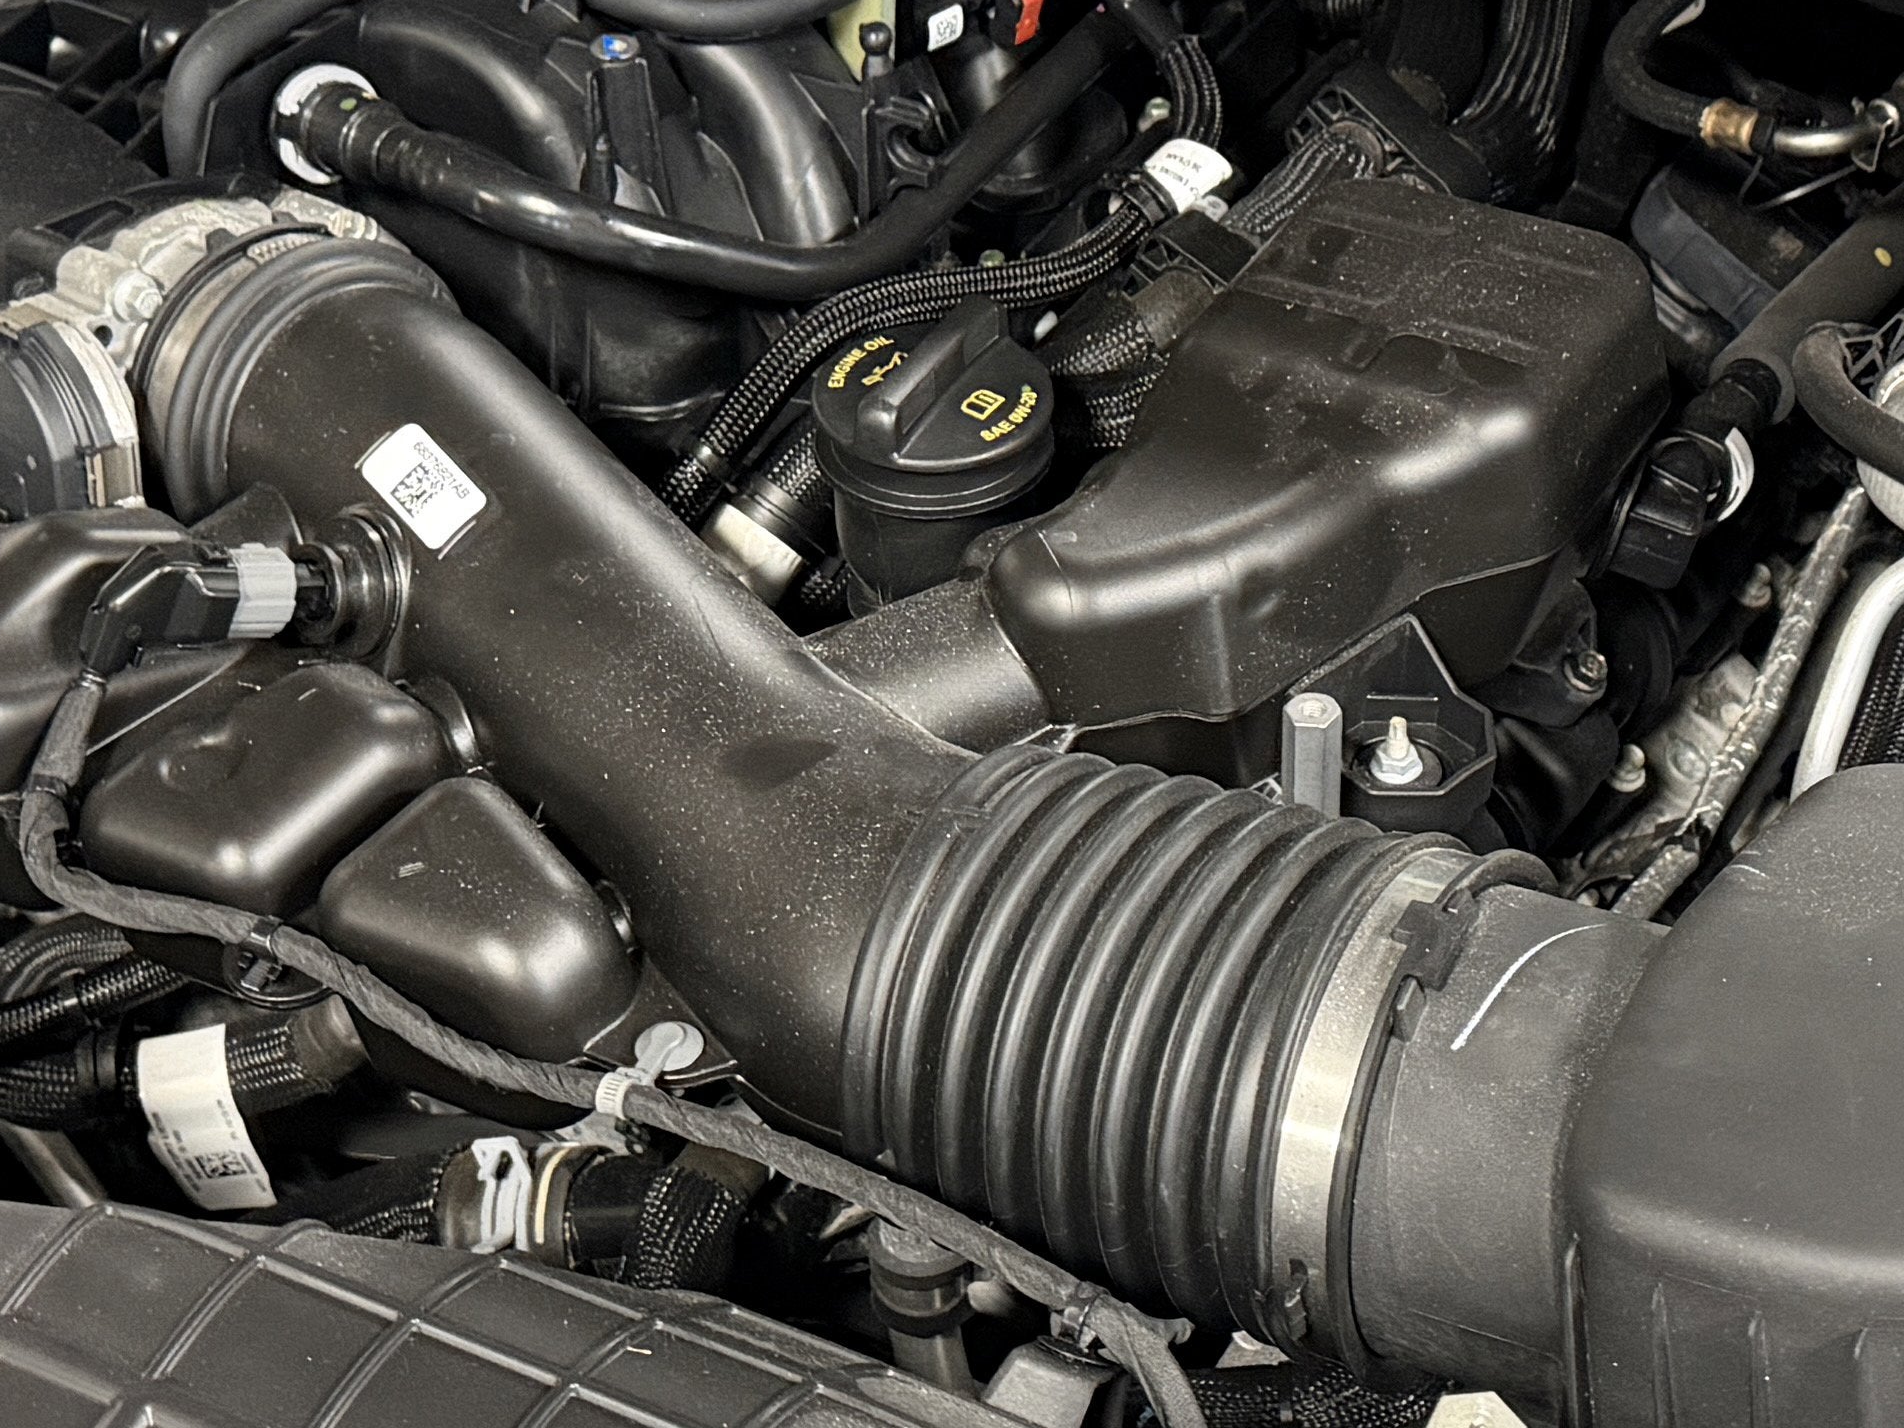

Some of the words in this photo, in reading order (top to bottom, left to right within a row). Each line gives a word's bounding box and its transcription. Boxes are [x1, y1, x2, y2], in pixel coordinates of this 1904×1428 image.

[827, 347, 867, 389] ENGINE
[863, 334, 895, 353] OIL
[979, 416, 1016, 442] SAE
[1012, 390, 1039, 425] 0W-20
